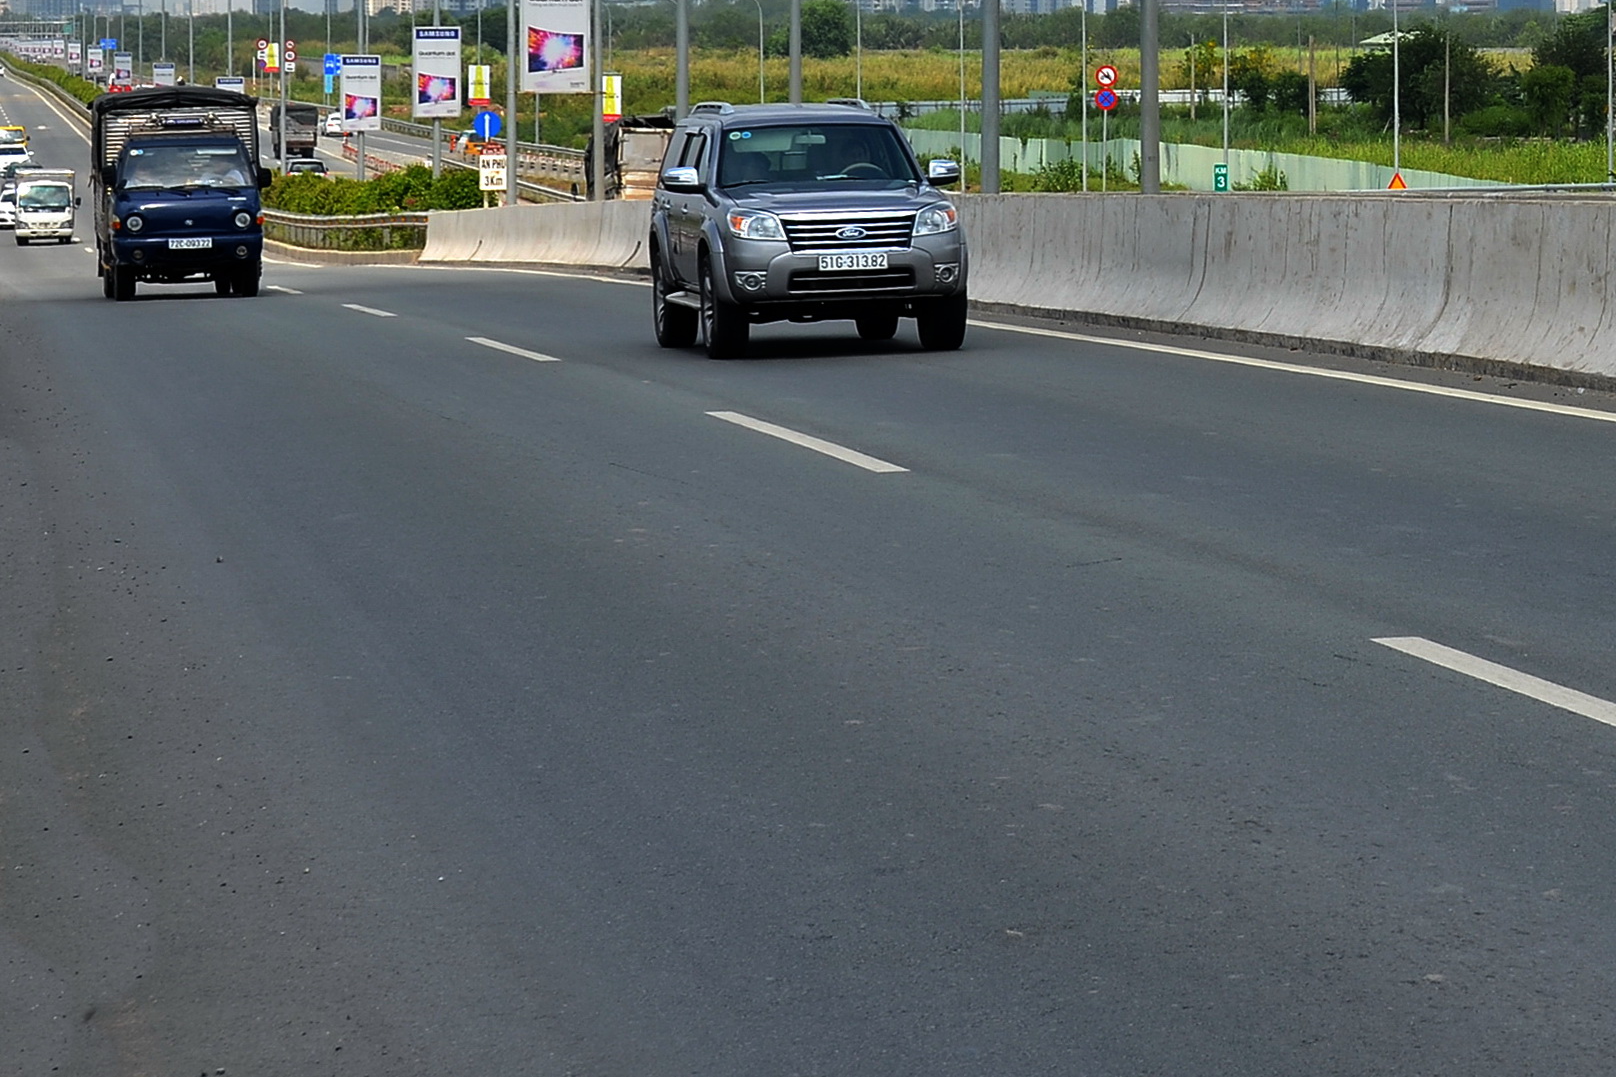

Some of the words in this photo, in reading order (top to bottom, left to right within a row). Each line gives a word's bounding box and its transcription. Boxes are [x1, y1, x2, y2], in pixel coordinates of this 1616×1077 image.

[481, 159, 491, 169] AN
[1217, 176, 1225, 187] 3
[820, 254, 886, 269] 51G-313.82
